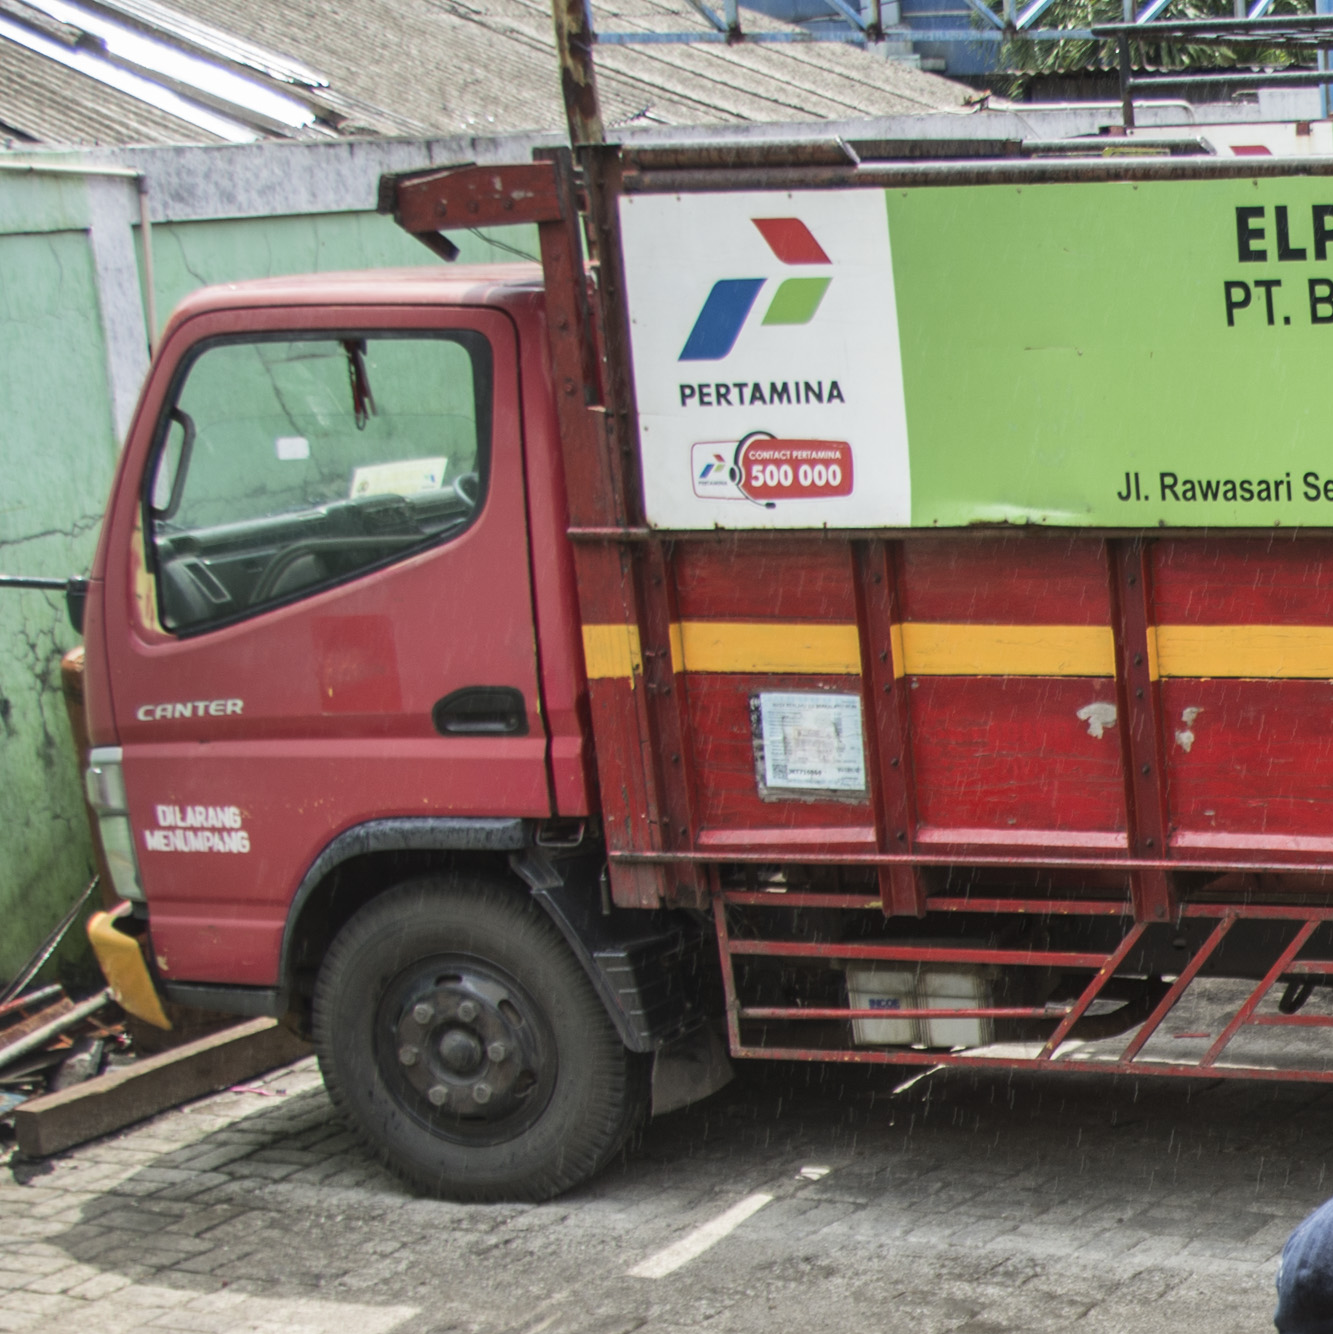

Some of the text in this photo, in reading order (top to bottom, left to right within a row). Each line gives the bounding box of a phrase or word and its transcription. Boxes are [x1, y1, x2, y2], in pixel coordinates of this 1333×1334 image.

[1224, 279, 1290, 327] PT.
[679, 380, 846, 407] PERTAMINA
[749, 450, 842, 460] CONTACT PERTAMINA
[751, 464, 842, 487] 500 000
[1116, 472, 1149, 503] Jl.
[1159, 472, 1293, 502] Rawasari
[136, 699, 244, 721] CANTER
[156, 804, 242, 829] DILARANG
[144, 829, 251, 854] MENUMPANG
